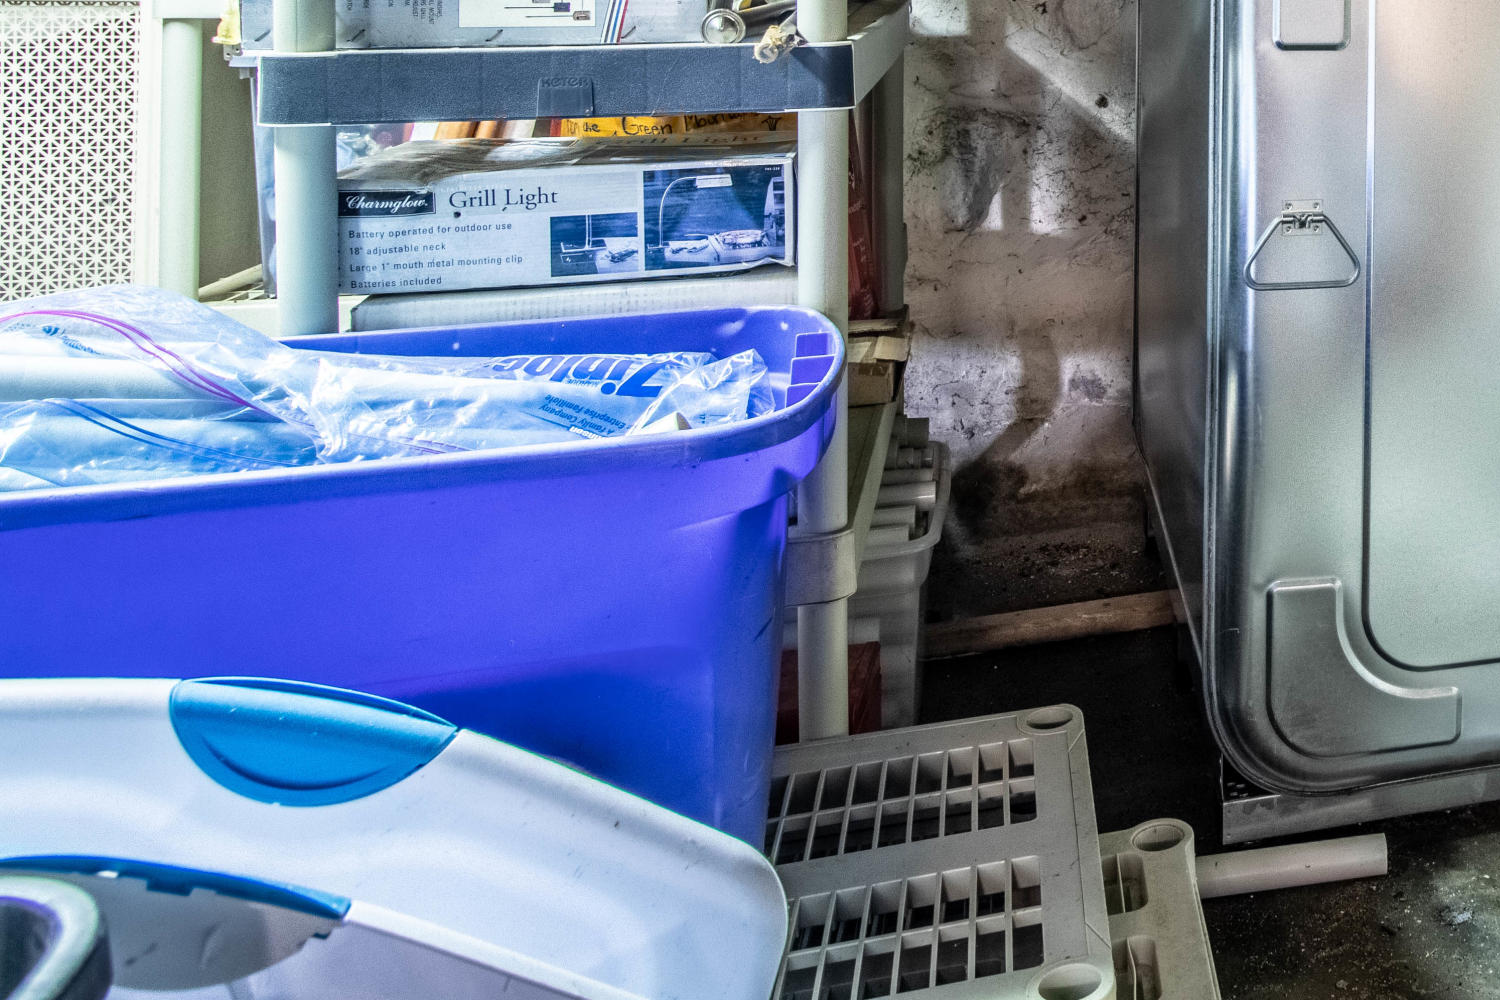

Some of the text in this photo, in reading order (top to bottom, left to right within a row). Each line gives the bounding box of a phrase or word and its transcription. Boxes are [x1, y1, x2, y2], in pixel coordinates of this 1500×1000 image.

[622, 117, 673, 136] Green
[449, 189, 497, 208] Grill
[504, 186, 559, 211] Light
[348, 222, 513, 240] Battery operated for outdoor use
[349, 242, 447, 258] 18" adjustable neck
[349, 264, 377, 274] Large
[393, 260, 424, 271] mouth
[427, 258, 455, 268] metal
[457, 255, 502, 267] mounting
[505, 254, 524, 265] clip
[350, 276, 443, 289] Batteries included
[538, 403, 578, 424] Company
[584, 407, 627, 430] Entreprise
[578, 417, 606, 434] Family
